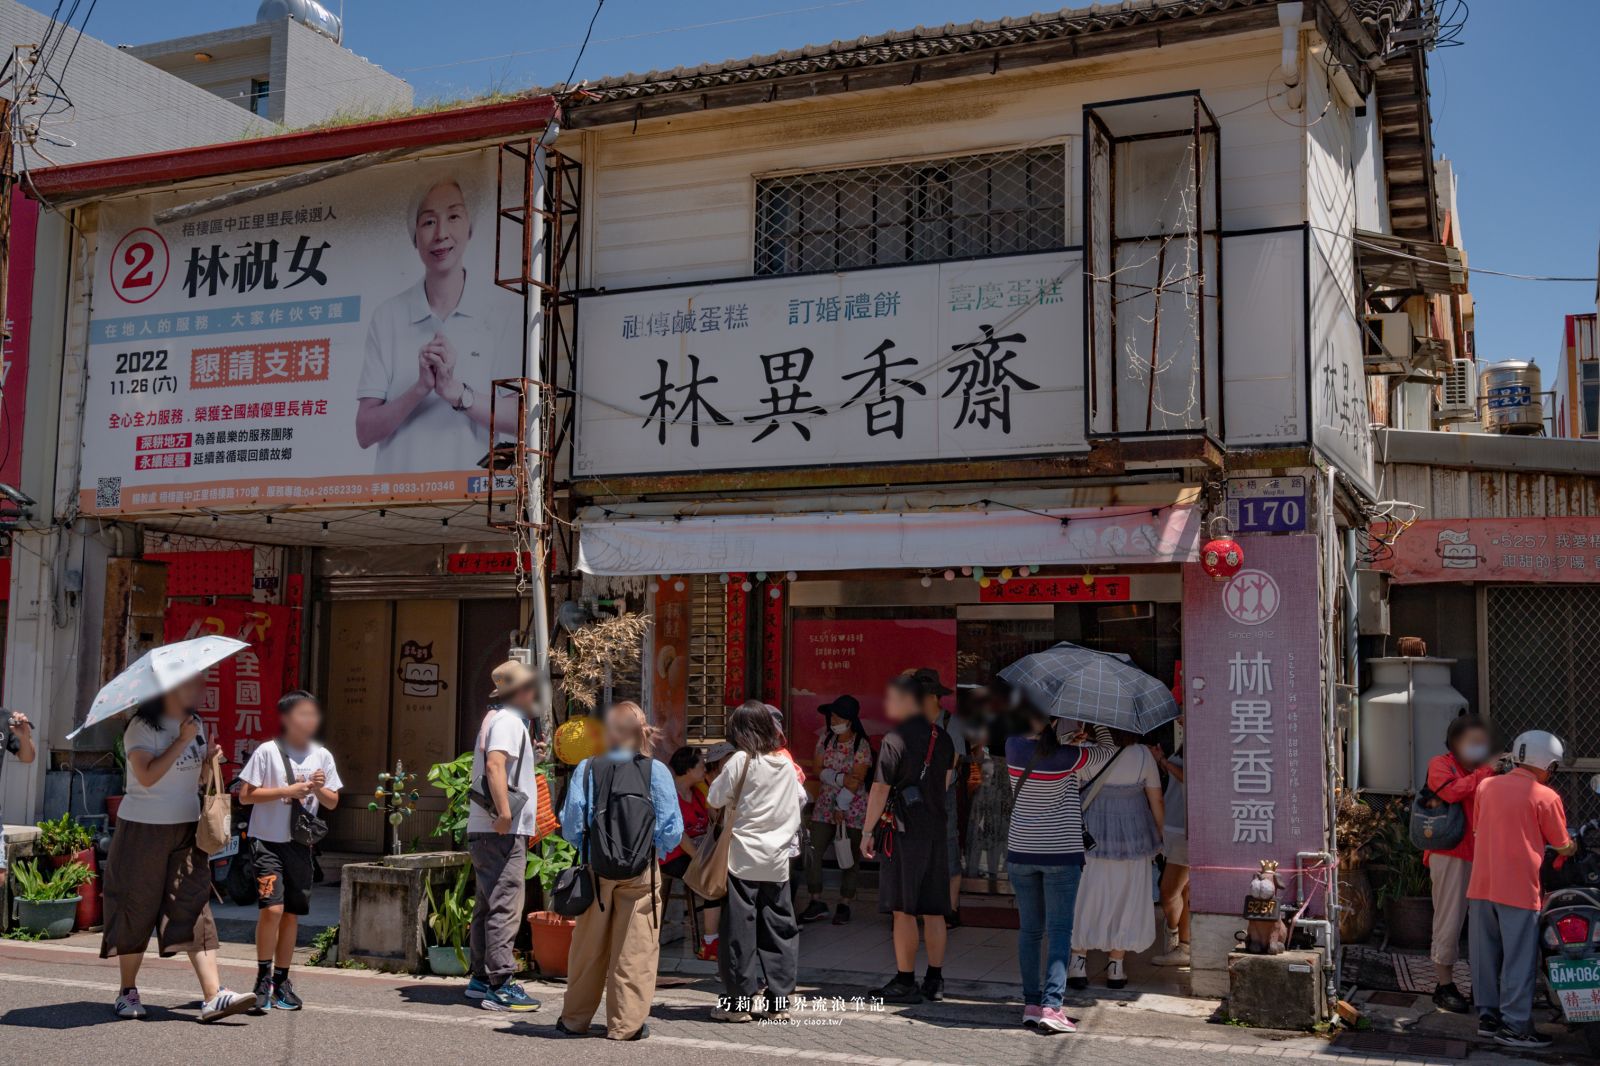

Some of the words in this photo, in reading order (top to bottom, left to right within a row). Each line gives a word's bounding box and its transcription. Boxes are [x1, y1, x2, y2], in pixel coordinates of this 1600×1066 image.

[182, 205, 337, 238] 梧棲區中正里里長候選人
[122, 242, 154, 289] 2
[182, 235, 332, 298] 林祝女
[787, 290, 902, 325] 訂婚禮餅
[115, 349, 169, 375] 2022
[193, 345, 327, 384] 懇請支持
[639, 324, 1041, 448] 林異香齋
[1243, 500, 1300, 526] 170
[1501, 535, 1548, 548] 5257
[1502, 554, 1585, 568] 甜甜的夕陽
[1228, 651, 1276, 843] 林異香齋
